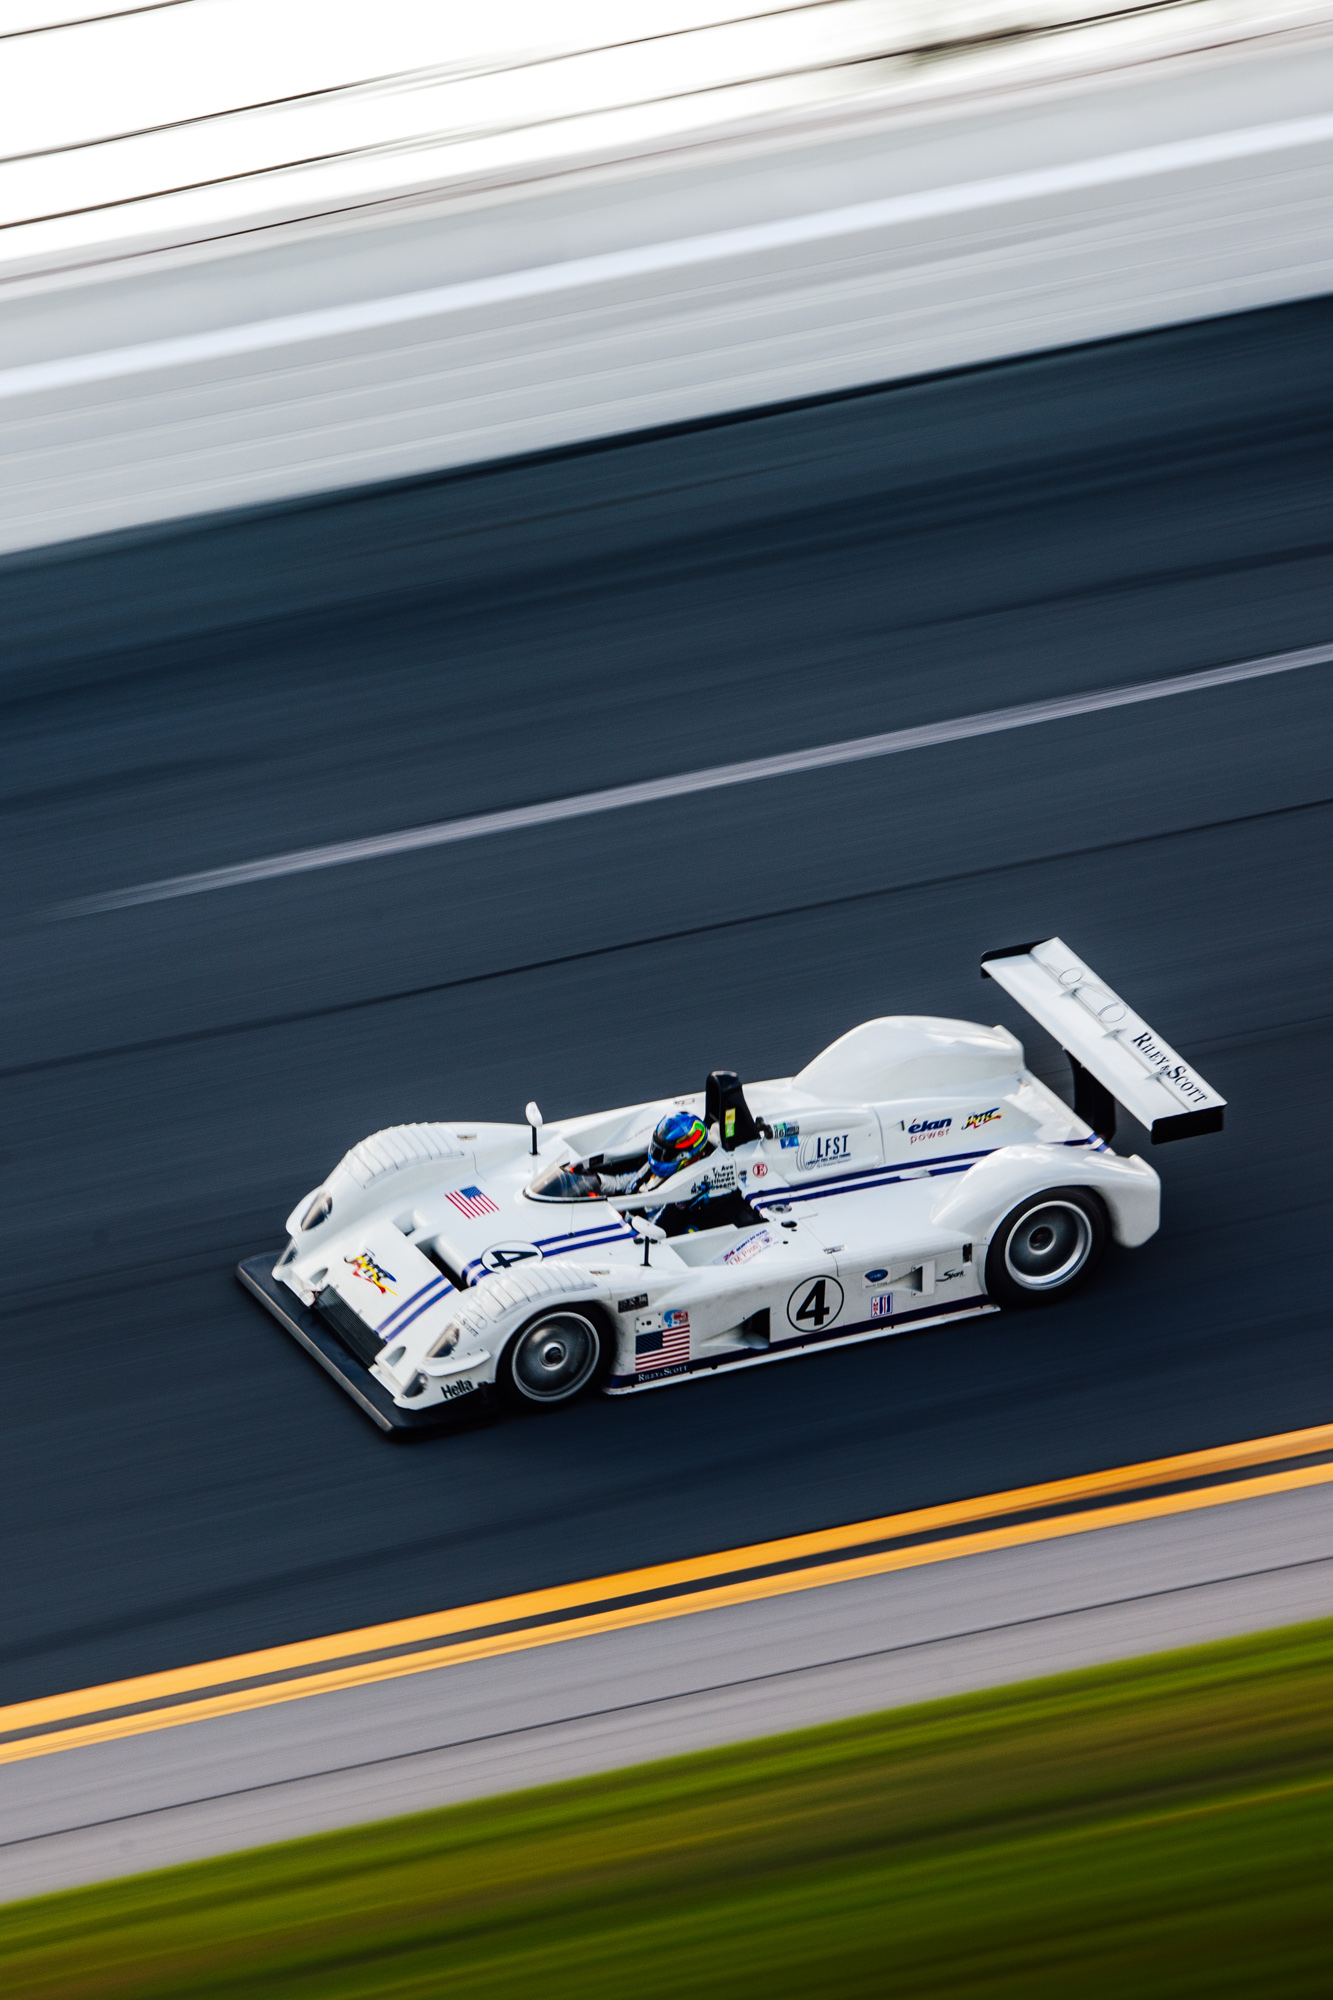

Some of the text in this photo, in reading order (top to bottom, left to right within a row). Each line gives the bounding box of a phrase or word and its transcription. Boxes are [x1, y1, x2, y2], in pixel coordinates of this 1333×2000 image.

[816, 1134, 849, 1159] LFST
[909, 1128, 951, 1146] power
[490, 1250, 540, 1269] 4
[795, 1278, 830, 1326] 4
[440, 1379, 474, 1400] Hella
